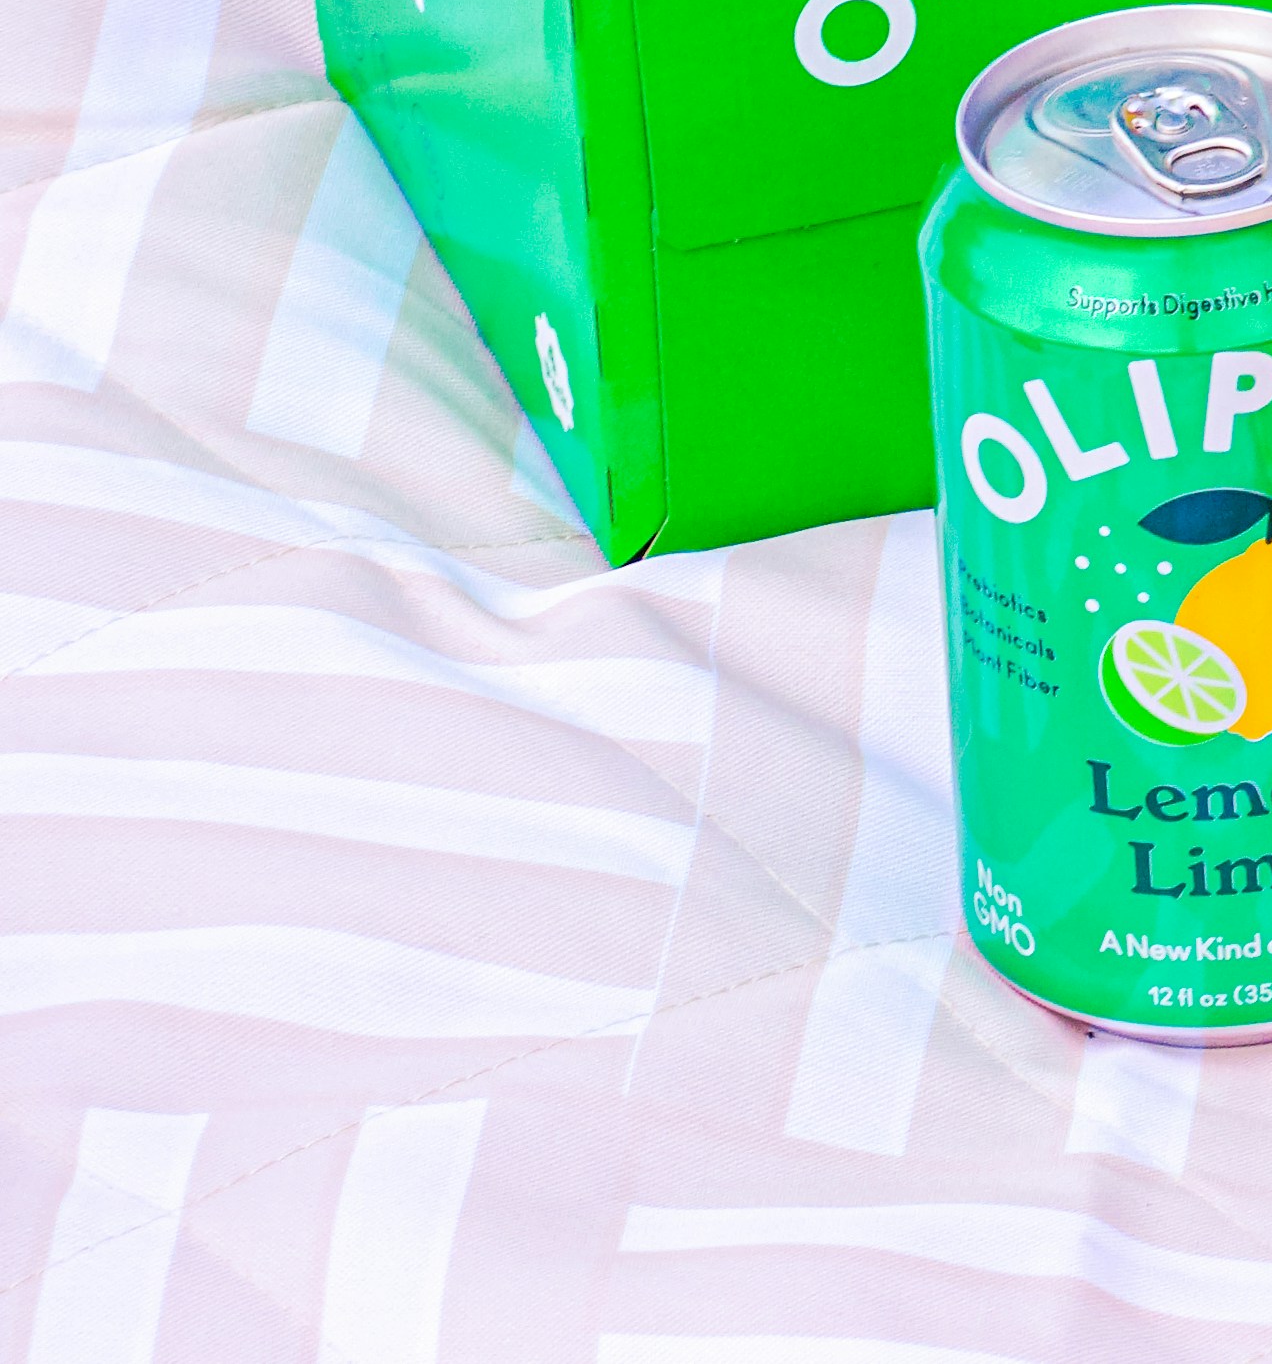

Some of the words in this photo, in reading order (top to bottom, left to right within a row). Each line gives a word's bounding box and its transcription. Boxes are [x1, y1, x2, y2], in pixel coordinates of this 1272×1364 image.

[1067, 286, 1160, 320] Supports
[1163, 286, 1261, 320] Digestive
[1007, 660, 1060, 697] Fiber
[977, 858, 1023, 918] Non
[973, 891, 1036, 957] GMO
[1099, 929, 1123, 956] A
[1125, 933, 1192, 962] New
[1195, 932, 1262, 962] Kind
[1148, 985, 1174, 1007] 12
[1177, 987, 1194, 1008] fl
[1199, 993, 1228, 1008] oz
